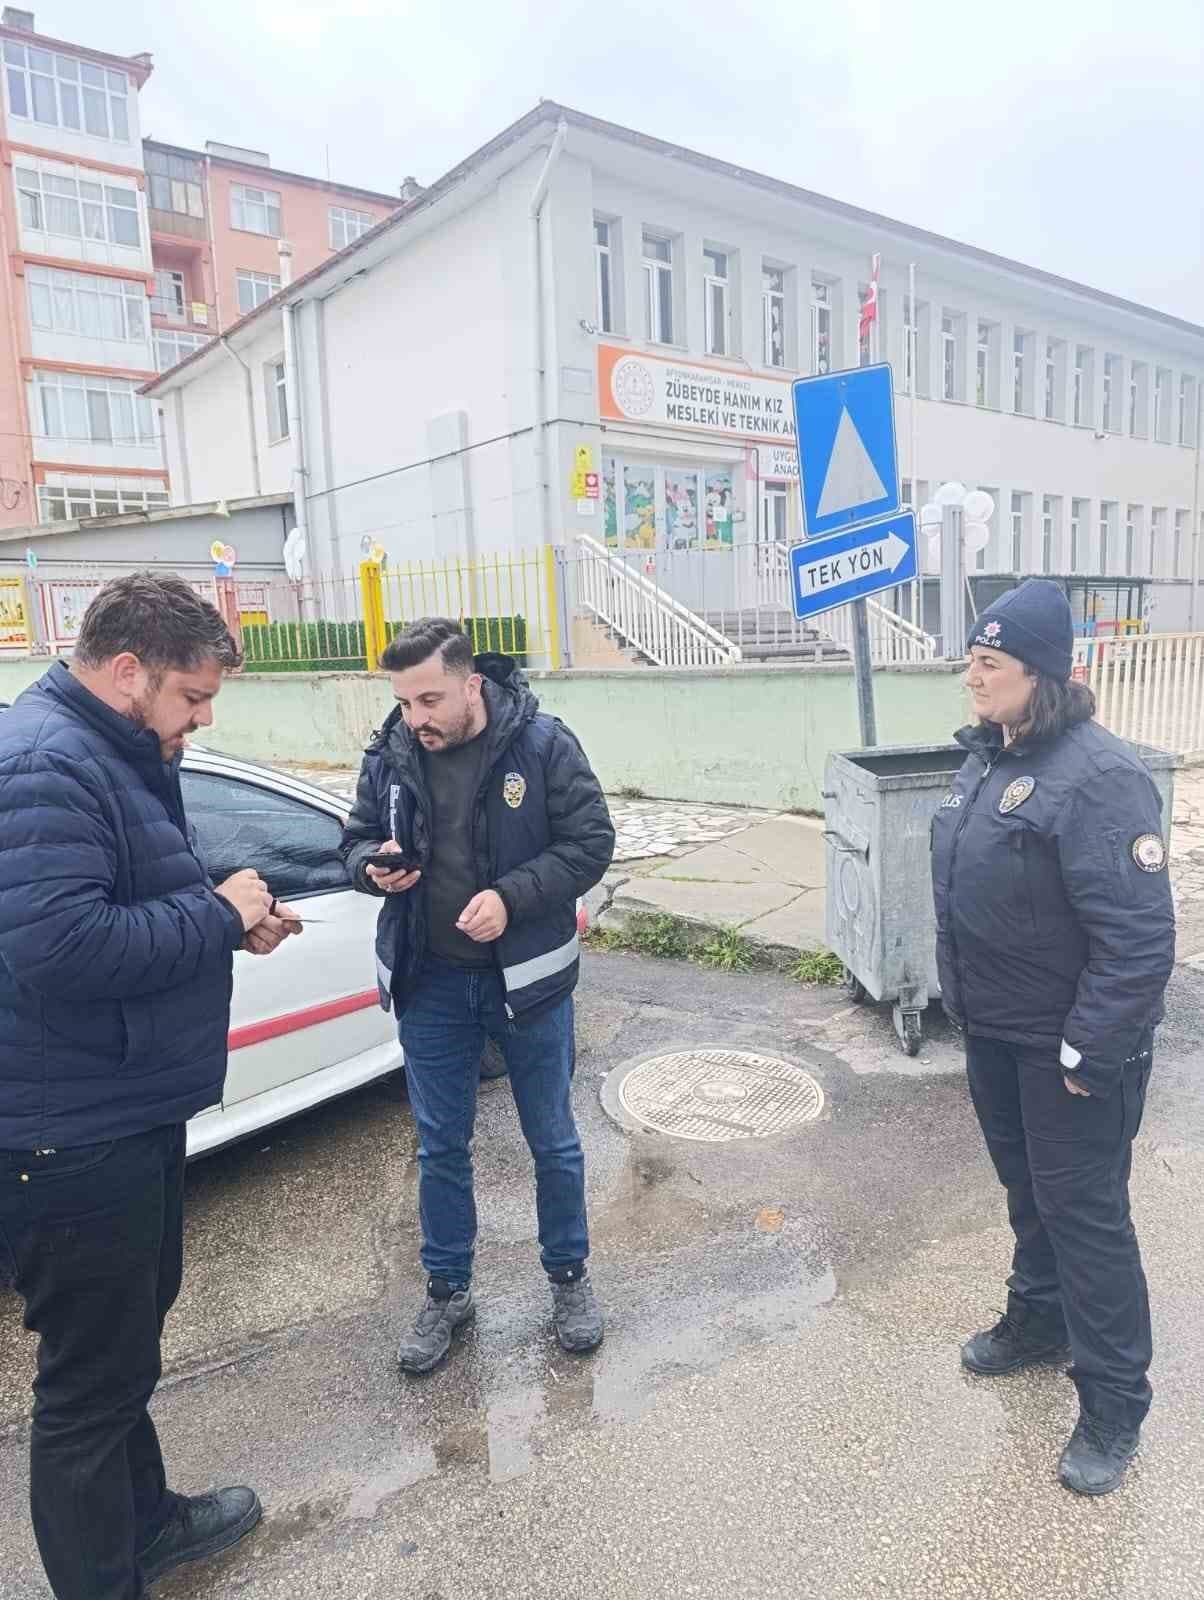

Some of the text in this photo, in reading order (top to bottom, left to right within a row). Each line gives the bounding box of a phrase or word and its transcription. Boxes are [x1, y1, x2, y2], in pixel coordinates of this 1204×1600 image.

[666, 378, 783, 413] ZÜBEYDE HANIM KIZ
[666, 403, 719, 425] MESLEKİ
[722, 411, 736, 428] VE
[808, 546, 883, 588] TEK YÖN
